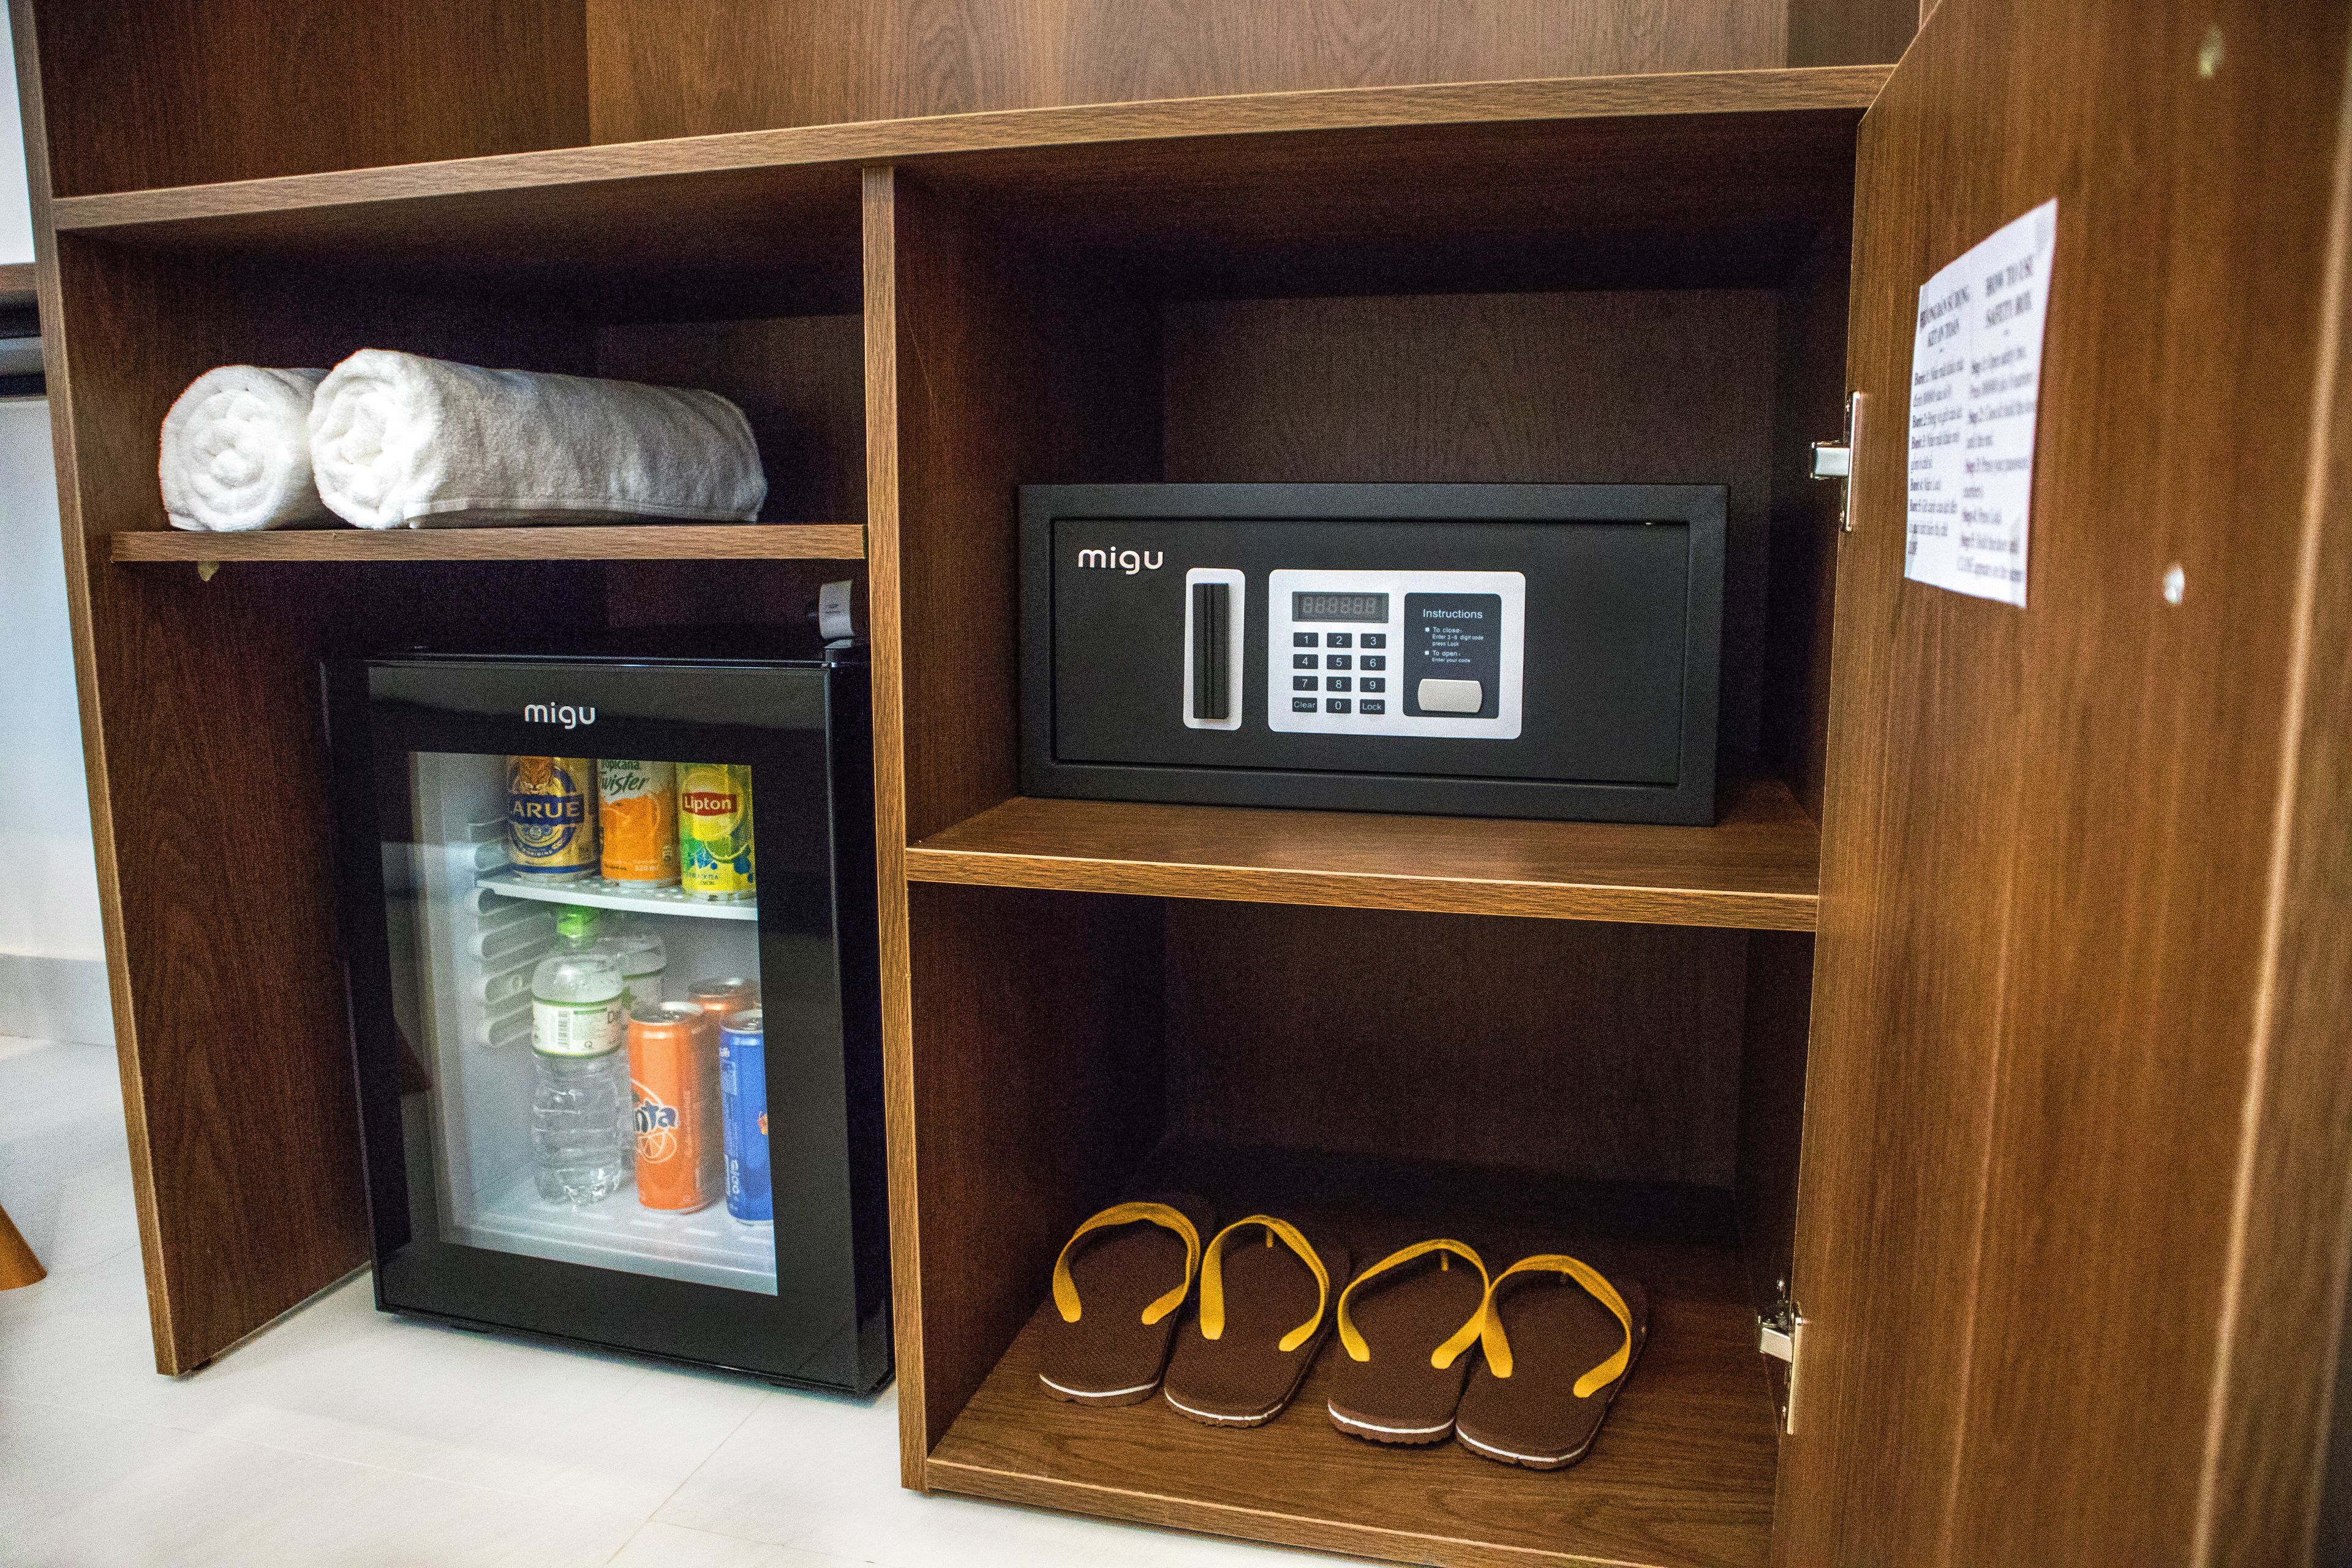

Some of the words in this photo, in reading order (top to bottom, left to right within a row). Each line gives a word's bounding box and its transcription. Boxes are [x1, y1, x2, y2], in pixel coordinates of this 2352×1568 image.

[1078, 546, 1163, 575] migu
[1423, 608, 1483, 619] Instructions
[1304, 635, 1309, 644] 1
[1336, 636, 1343, 645] 2
[1370, 636, 1376, 646] 3
[1302, 657, 1308, 666] 4
[1336, 658, 1343, 666] 5
[1370, 658, 1376, 667] 6
[1302, 679, 1308, 688] 7
[1336, 680, 1342, 688] 8
[1370, 680, 1376, 690] 9
[1335, 701, 1341, 710] 0
[524, 702, 595, 729] migu
[685, 796, 732, 813] Lipton
